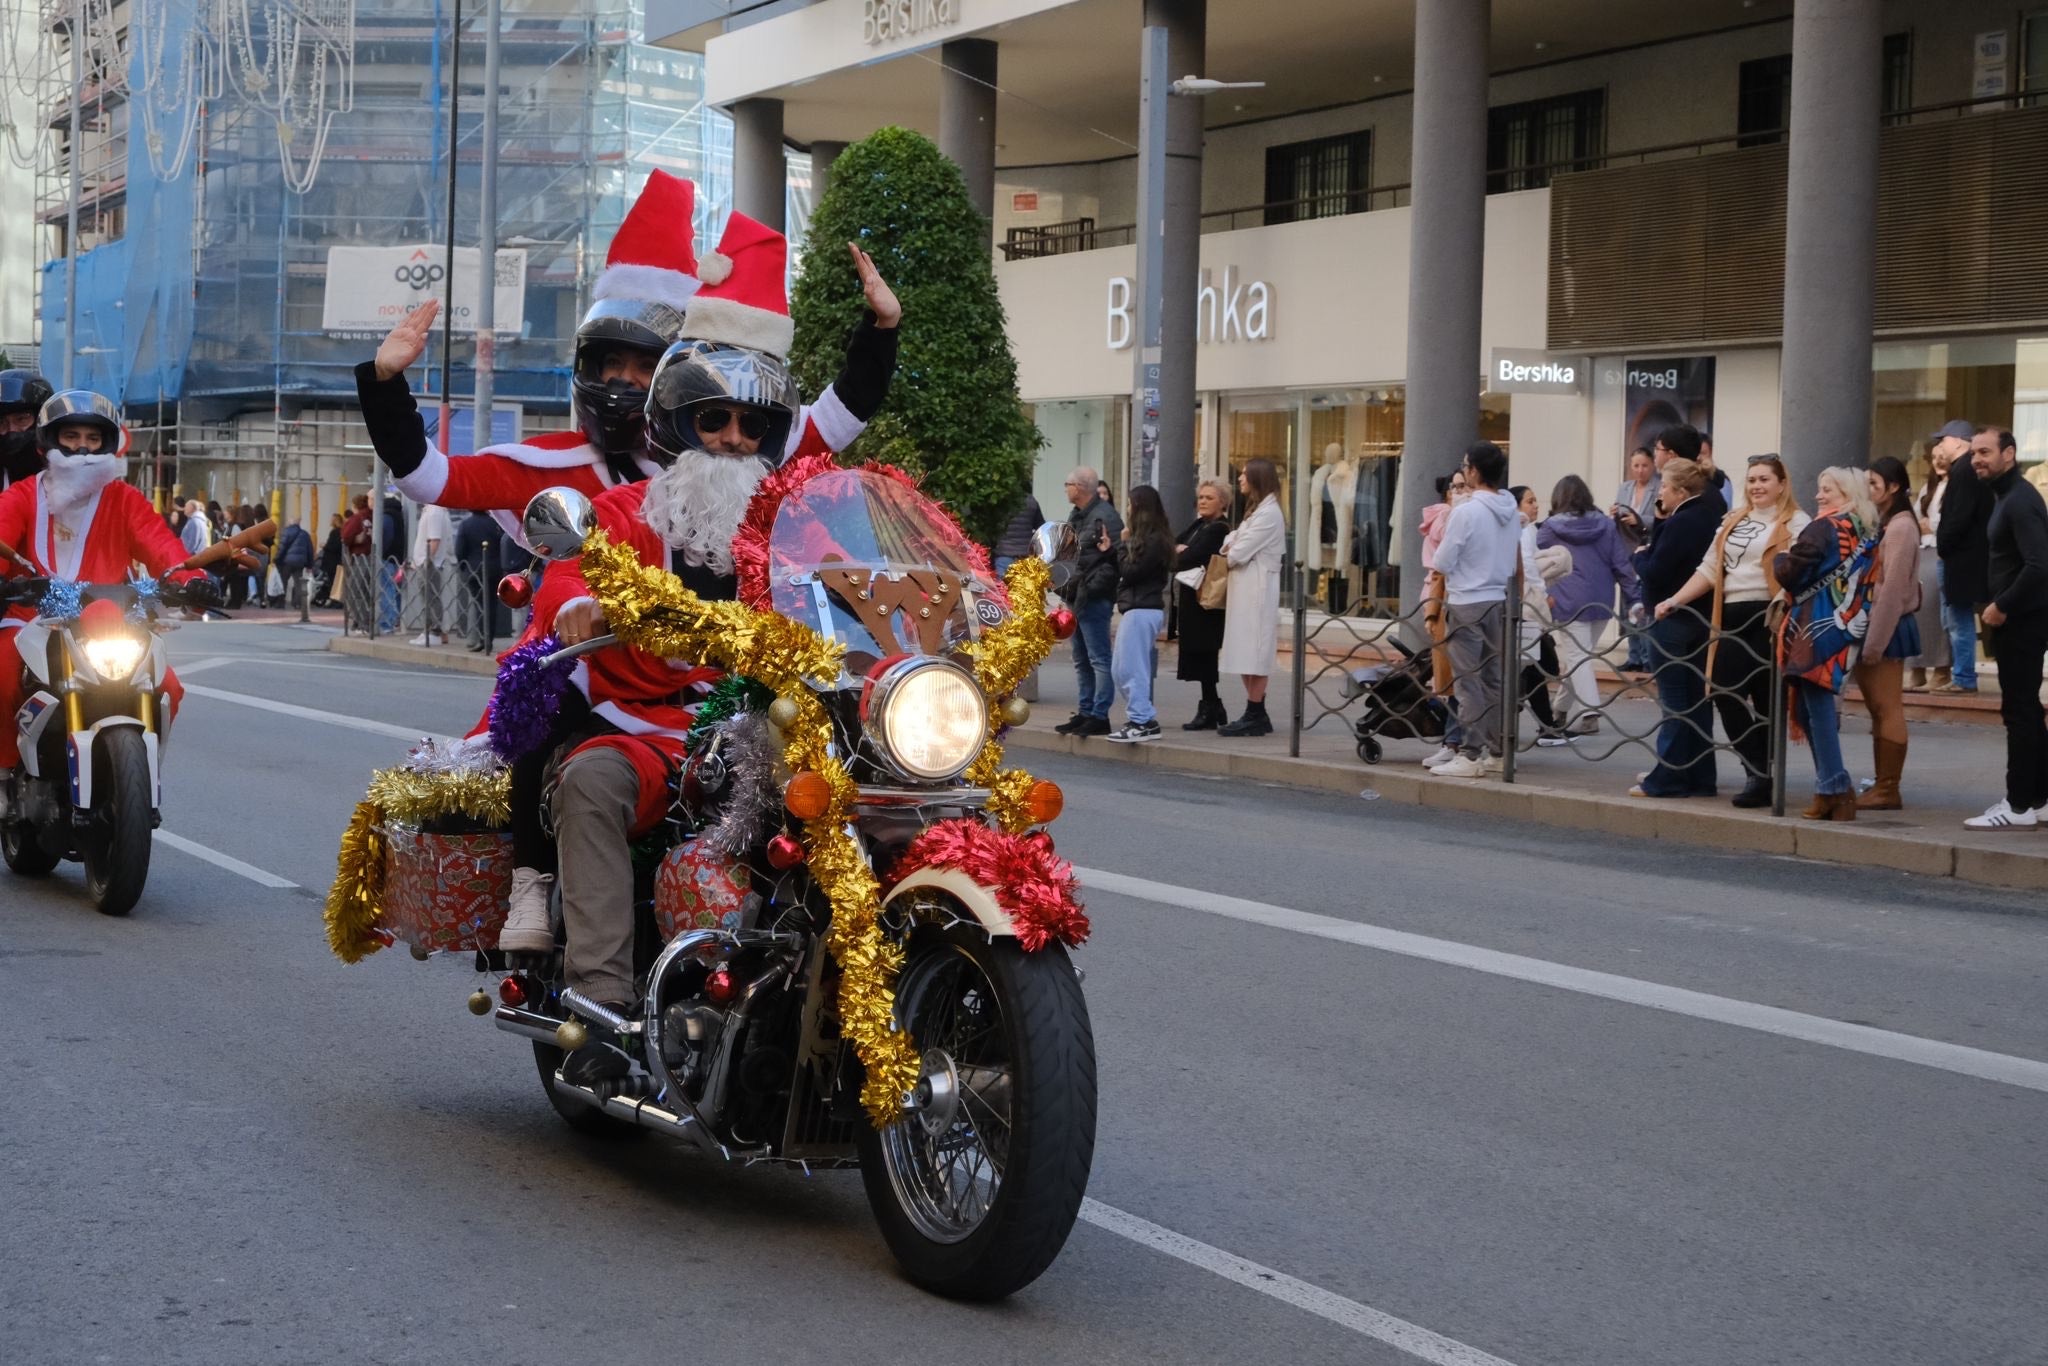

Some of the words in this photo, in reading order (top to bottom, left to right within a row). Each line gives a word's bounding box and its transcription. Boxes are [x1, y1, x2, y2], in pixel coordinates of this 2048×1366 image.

[1107, 265, 1269, 350] Bhka
[1499, 359, 1575, 384] Bershka
[979, 604, 1000, 619] 59
